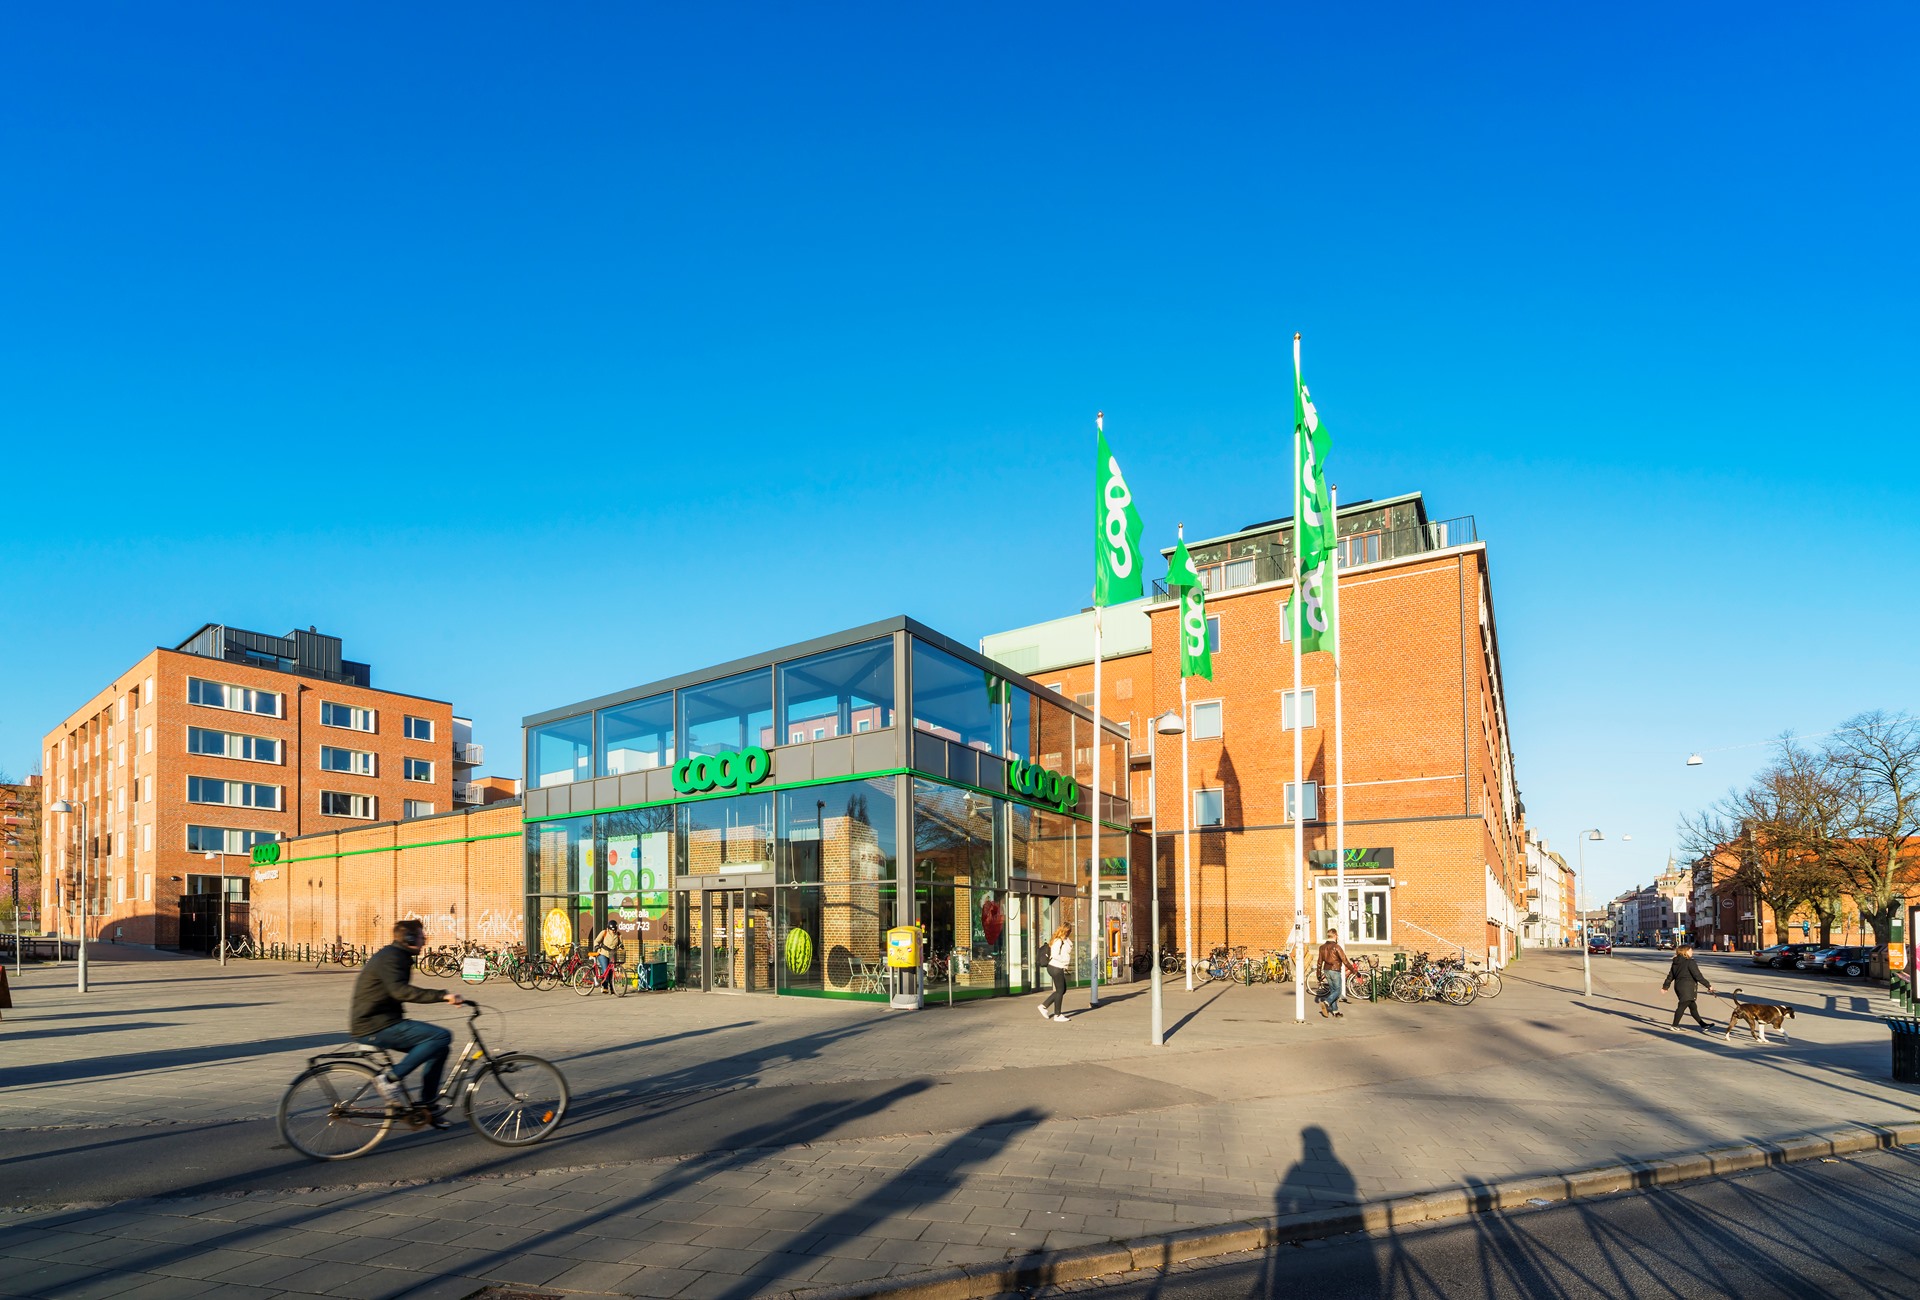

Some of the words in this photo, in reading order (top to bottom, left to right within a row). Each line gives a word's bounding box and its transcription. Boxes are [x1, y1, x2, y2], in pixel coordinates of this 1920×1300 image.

[1184, 557, 1206, 656] coo
[672, 746, 770, 794] coop
[1010, 759, 1079, 813] coop
[253, 843, 280, 864] coop
[618, 921, 636, 932] dagar
[636, 921, 650, 931] 7-23
[619, 907, 638, 919] Öppet
[638, 908, 649, 918] alla
